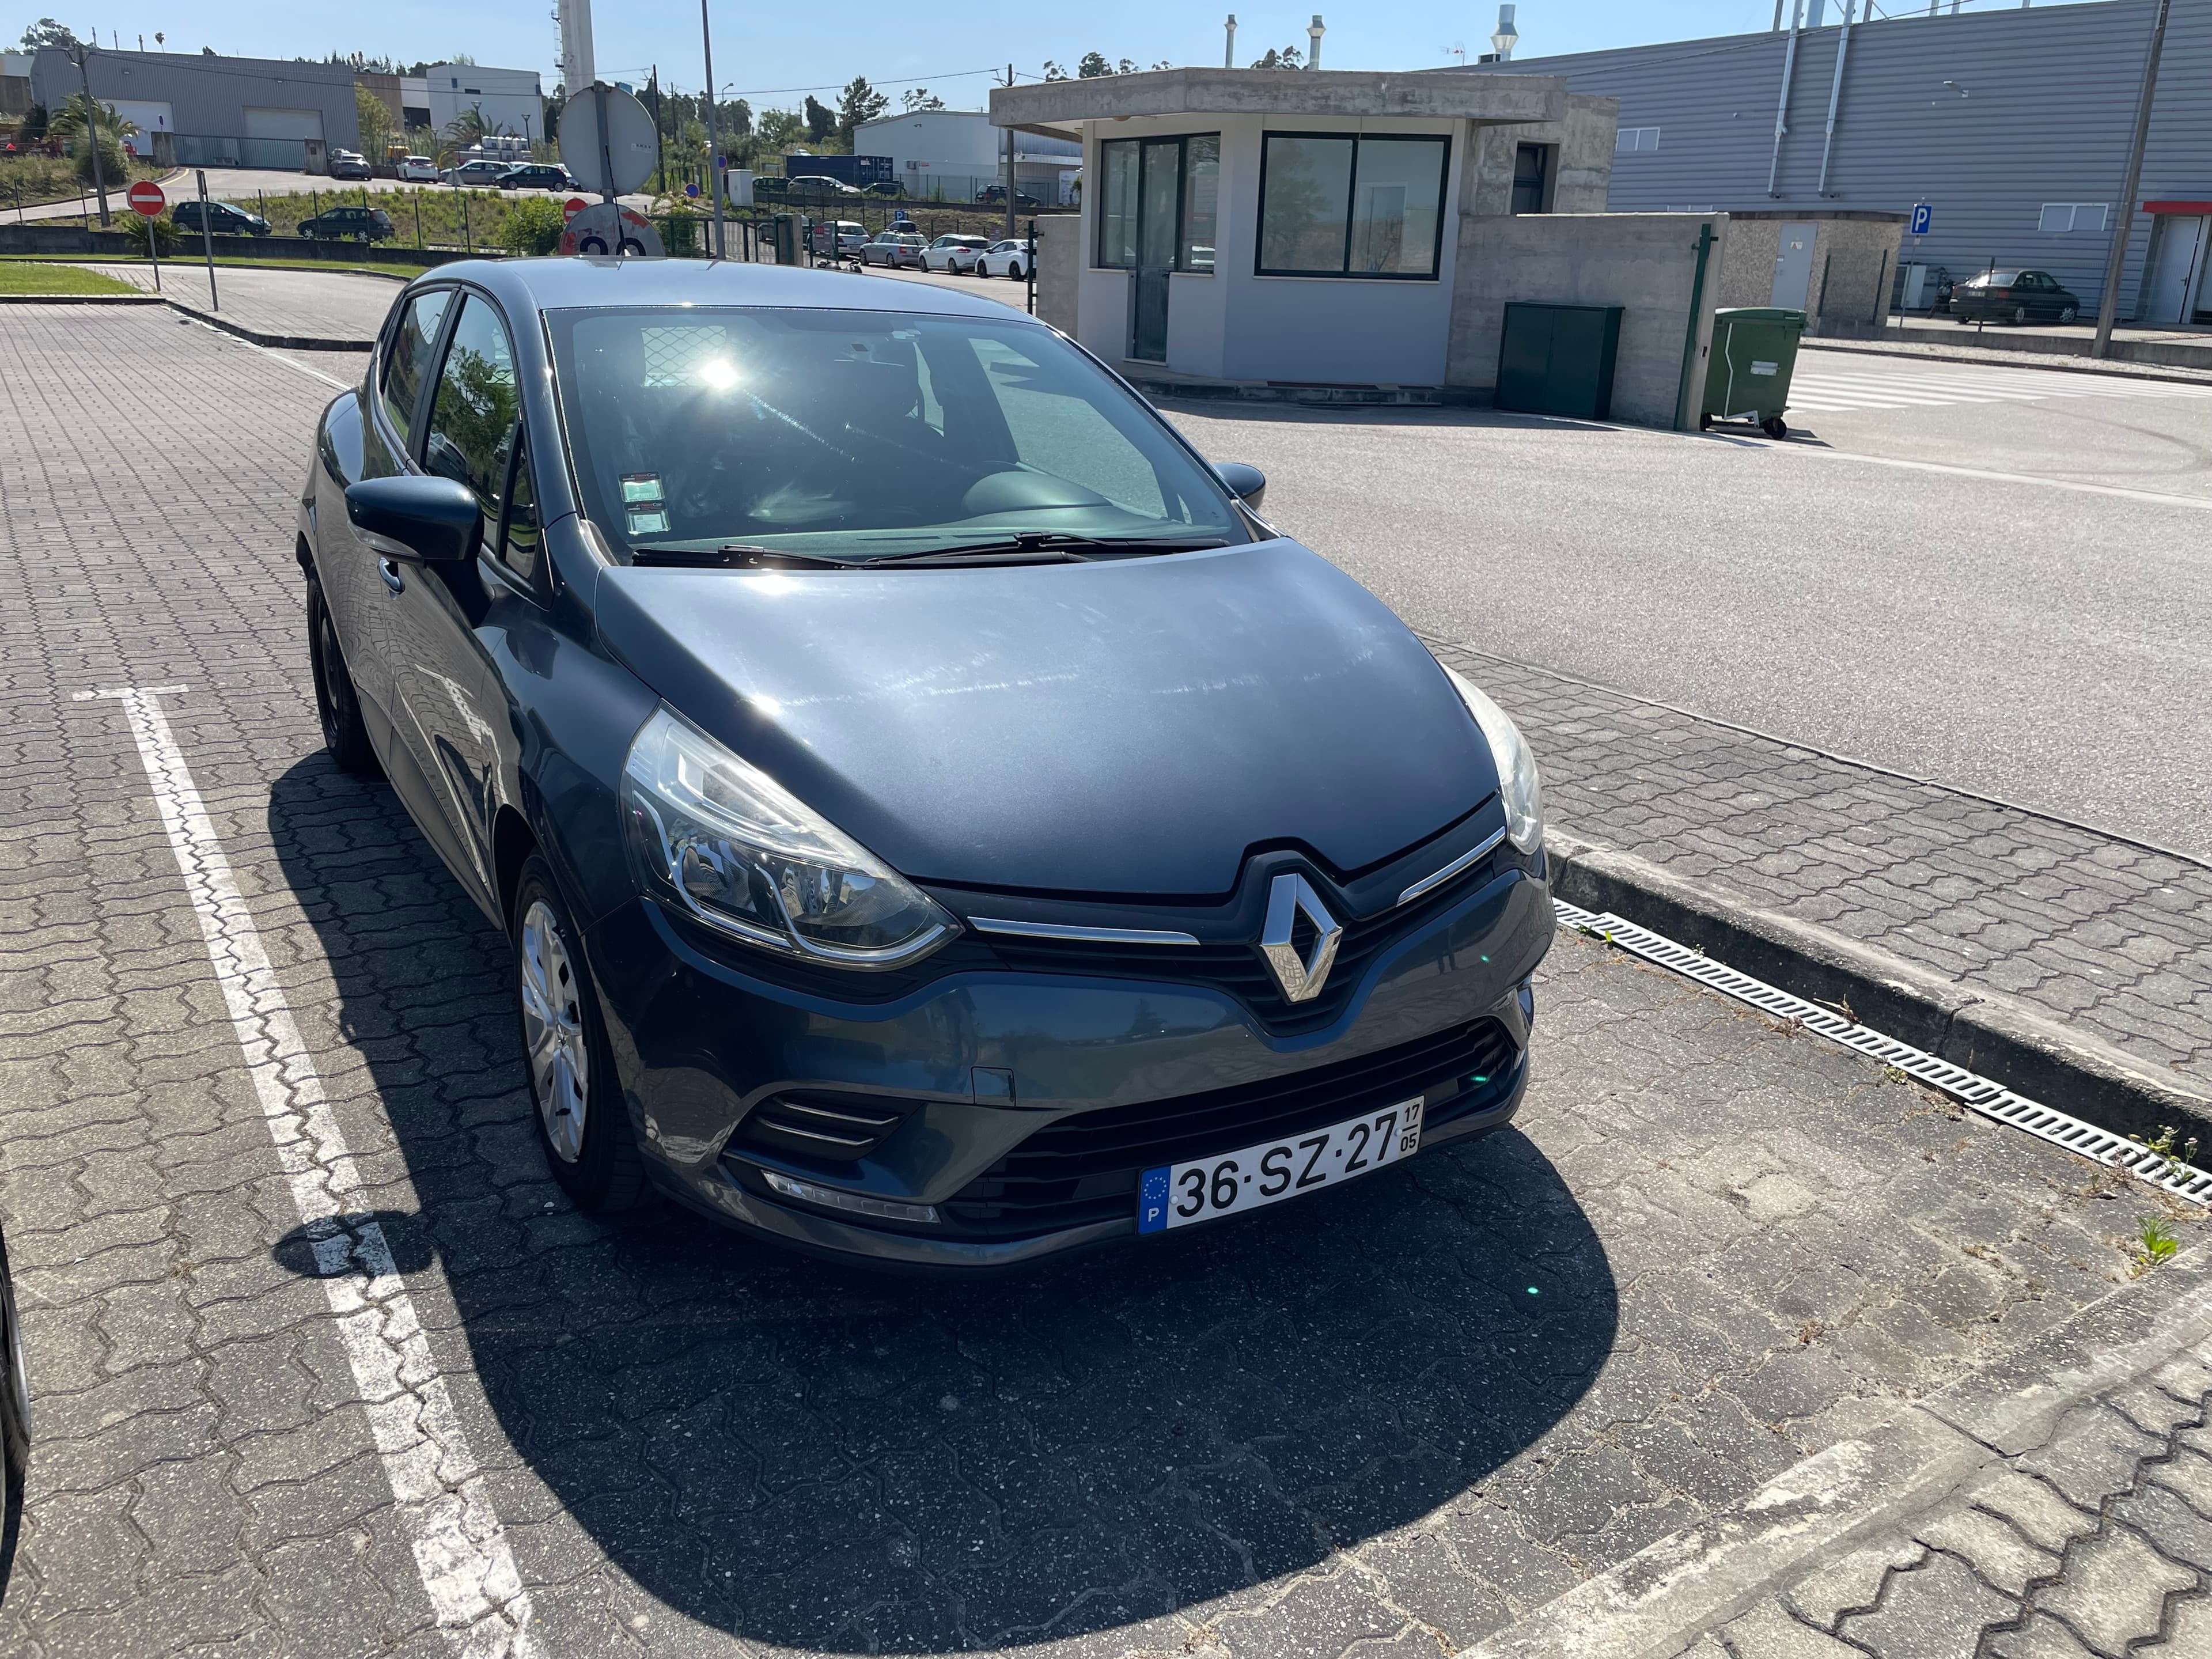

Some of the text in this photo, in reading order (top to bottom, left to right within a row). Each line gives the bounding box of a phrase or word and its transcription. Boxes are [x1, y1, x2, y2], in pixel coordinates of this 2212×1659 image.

[896, 211, 903, 220] P
[1915, 208, 1927, 232] P
[1404, 1103, 1420, 1123] 17
[1400, 1132, 1418, 1152] 05
[1147, 1207, 1160, 1222] P
